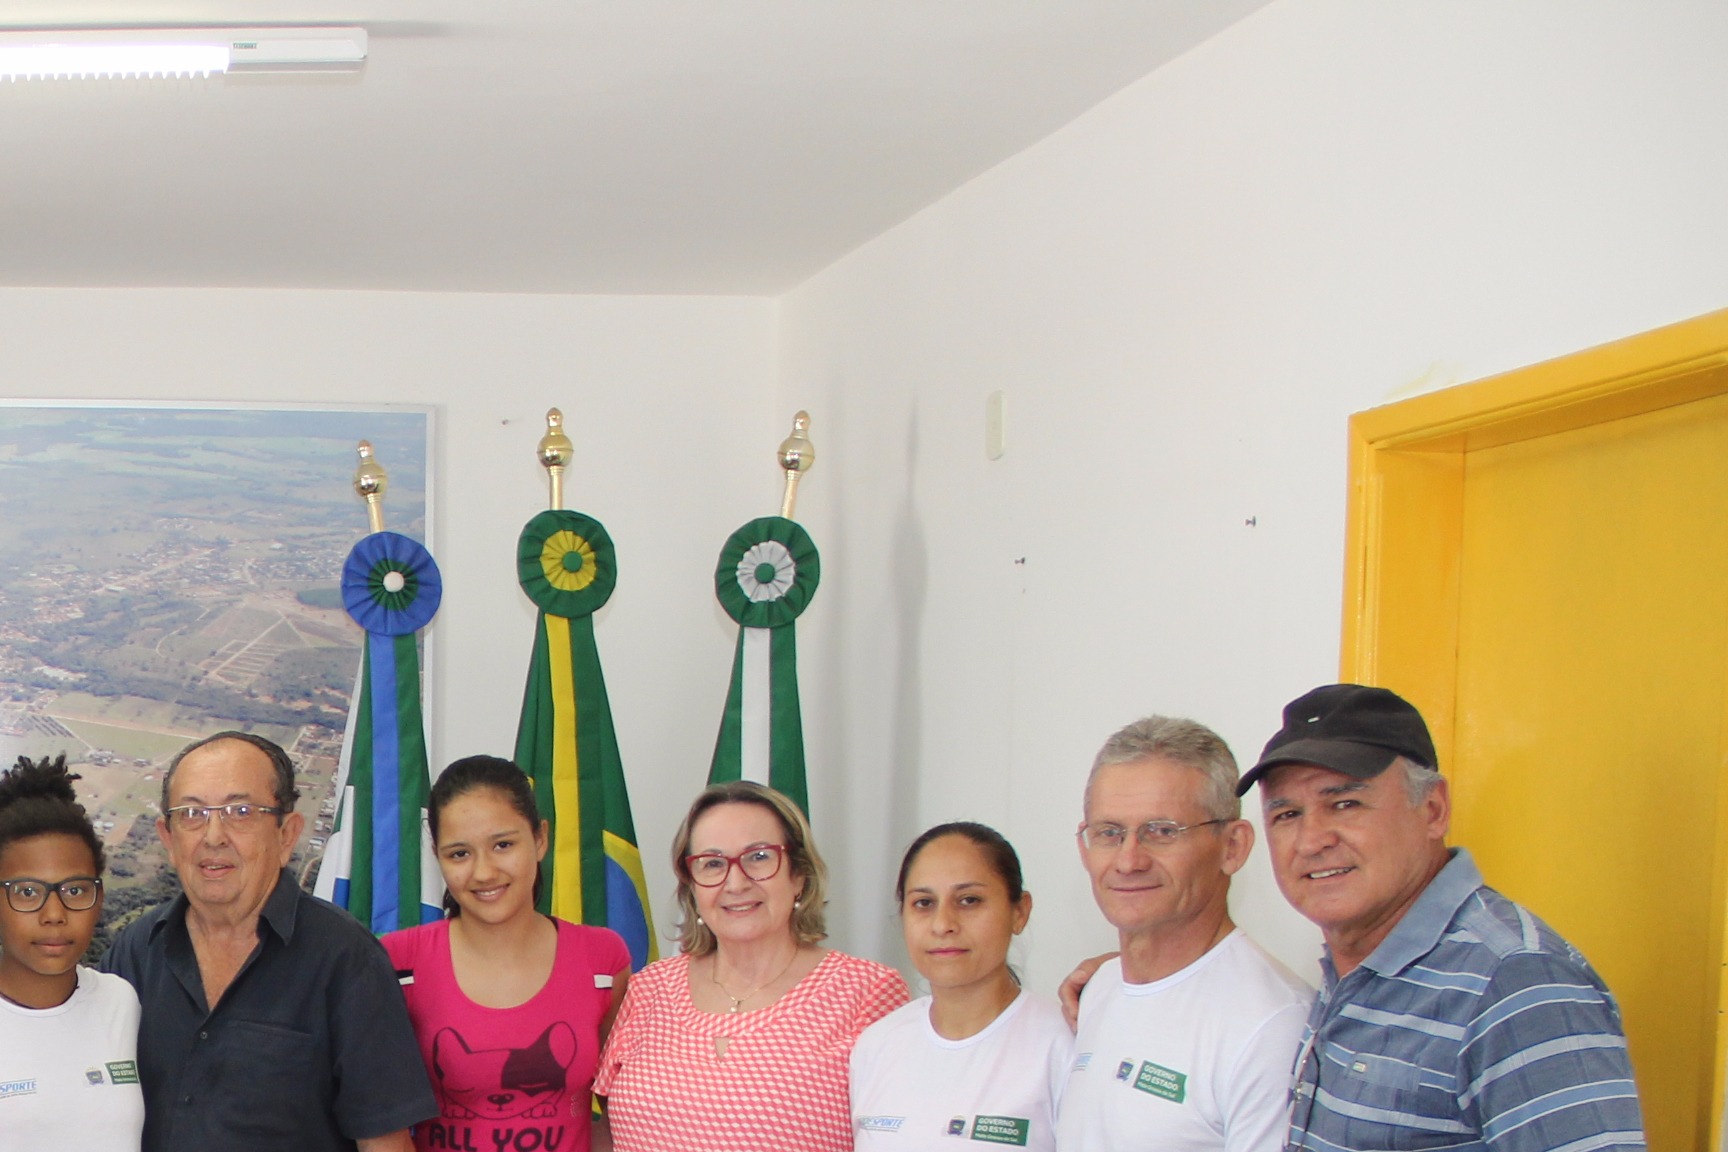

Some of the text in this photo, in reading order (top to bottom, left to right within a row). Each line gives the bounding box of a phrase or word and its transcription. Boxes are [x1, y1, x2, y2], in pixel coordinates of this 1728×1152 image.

[1144, 1064, 1176, 1081] GOVERNO
[1140, 1072, 1179, 1091] DO ESTADO
[976, 1124, 1019, 1136] DO ESTADO
[978, 1117, 1015, 1127] GOVERNO
[429, 1122, 564, 1152] ALL YOU
